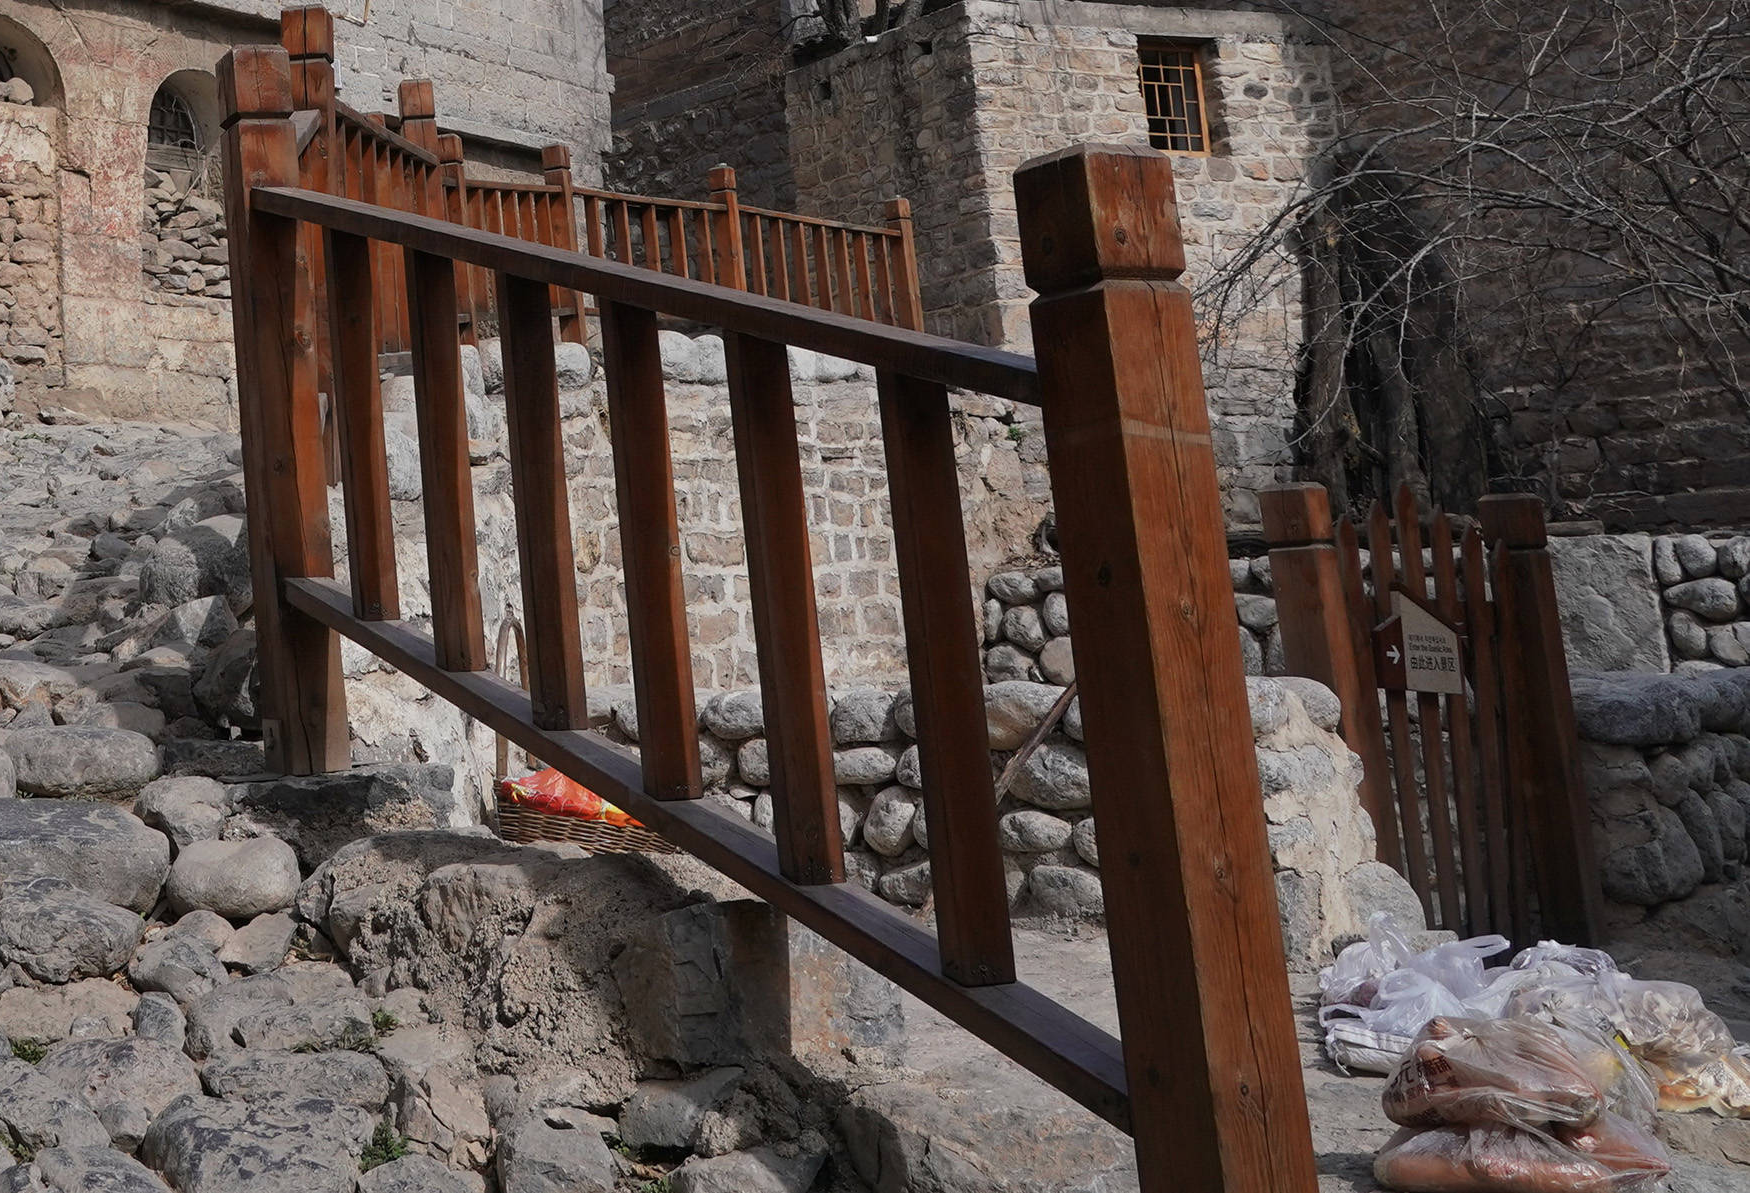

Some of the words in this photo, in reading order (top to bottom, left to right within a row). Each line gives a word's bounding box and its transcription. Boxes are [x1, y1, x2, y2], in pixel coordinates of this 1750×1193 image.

[1410, 654, 1456, 673] 由此进入景区
